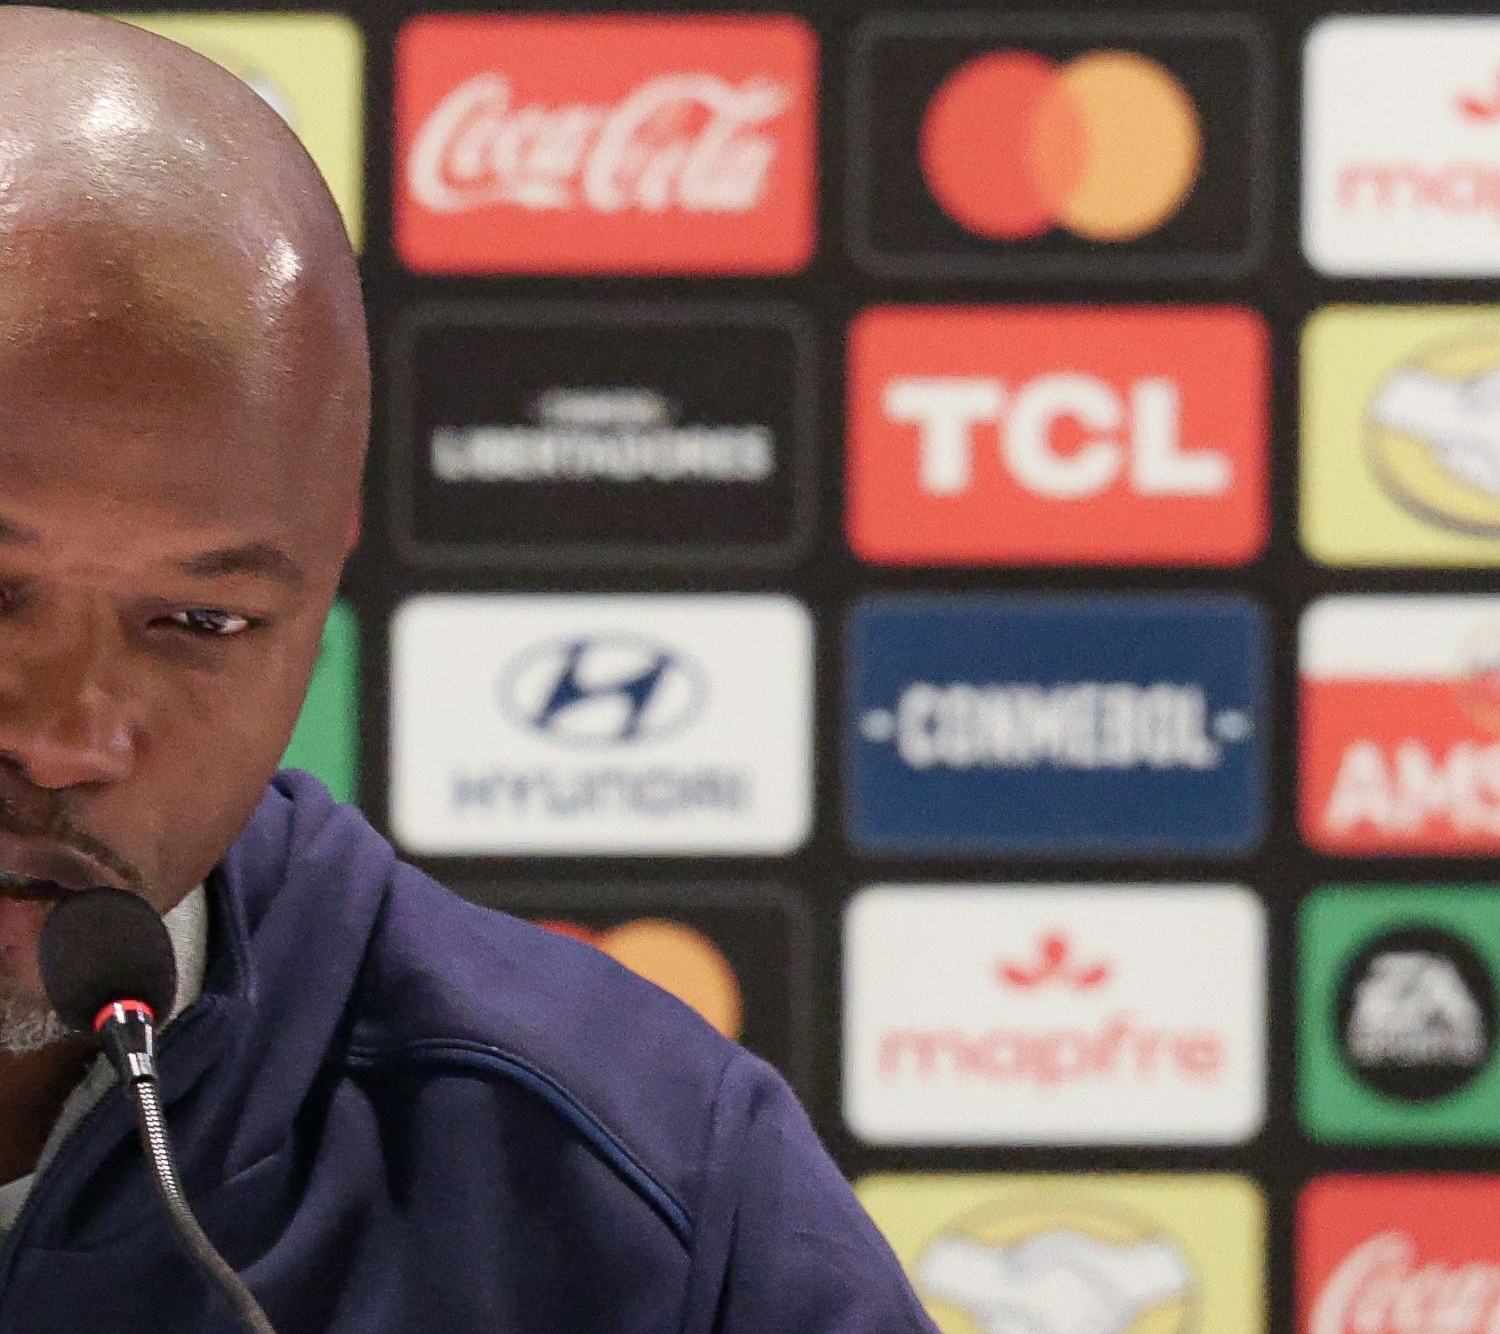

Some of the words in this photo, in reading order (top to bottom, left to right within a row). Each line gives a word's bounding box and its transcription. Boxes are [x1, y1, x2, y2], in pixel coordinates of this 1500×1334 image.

[408, 71, 788, 213] Coca-Cola
[883, 372, 1232, 499] TCL
[451, 767, 751, 818] HYUNDAI
[877, 1013, 1228, 1090] mapfre
